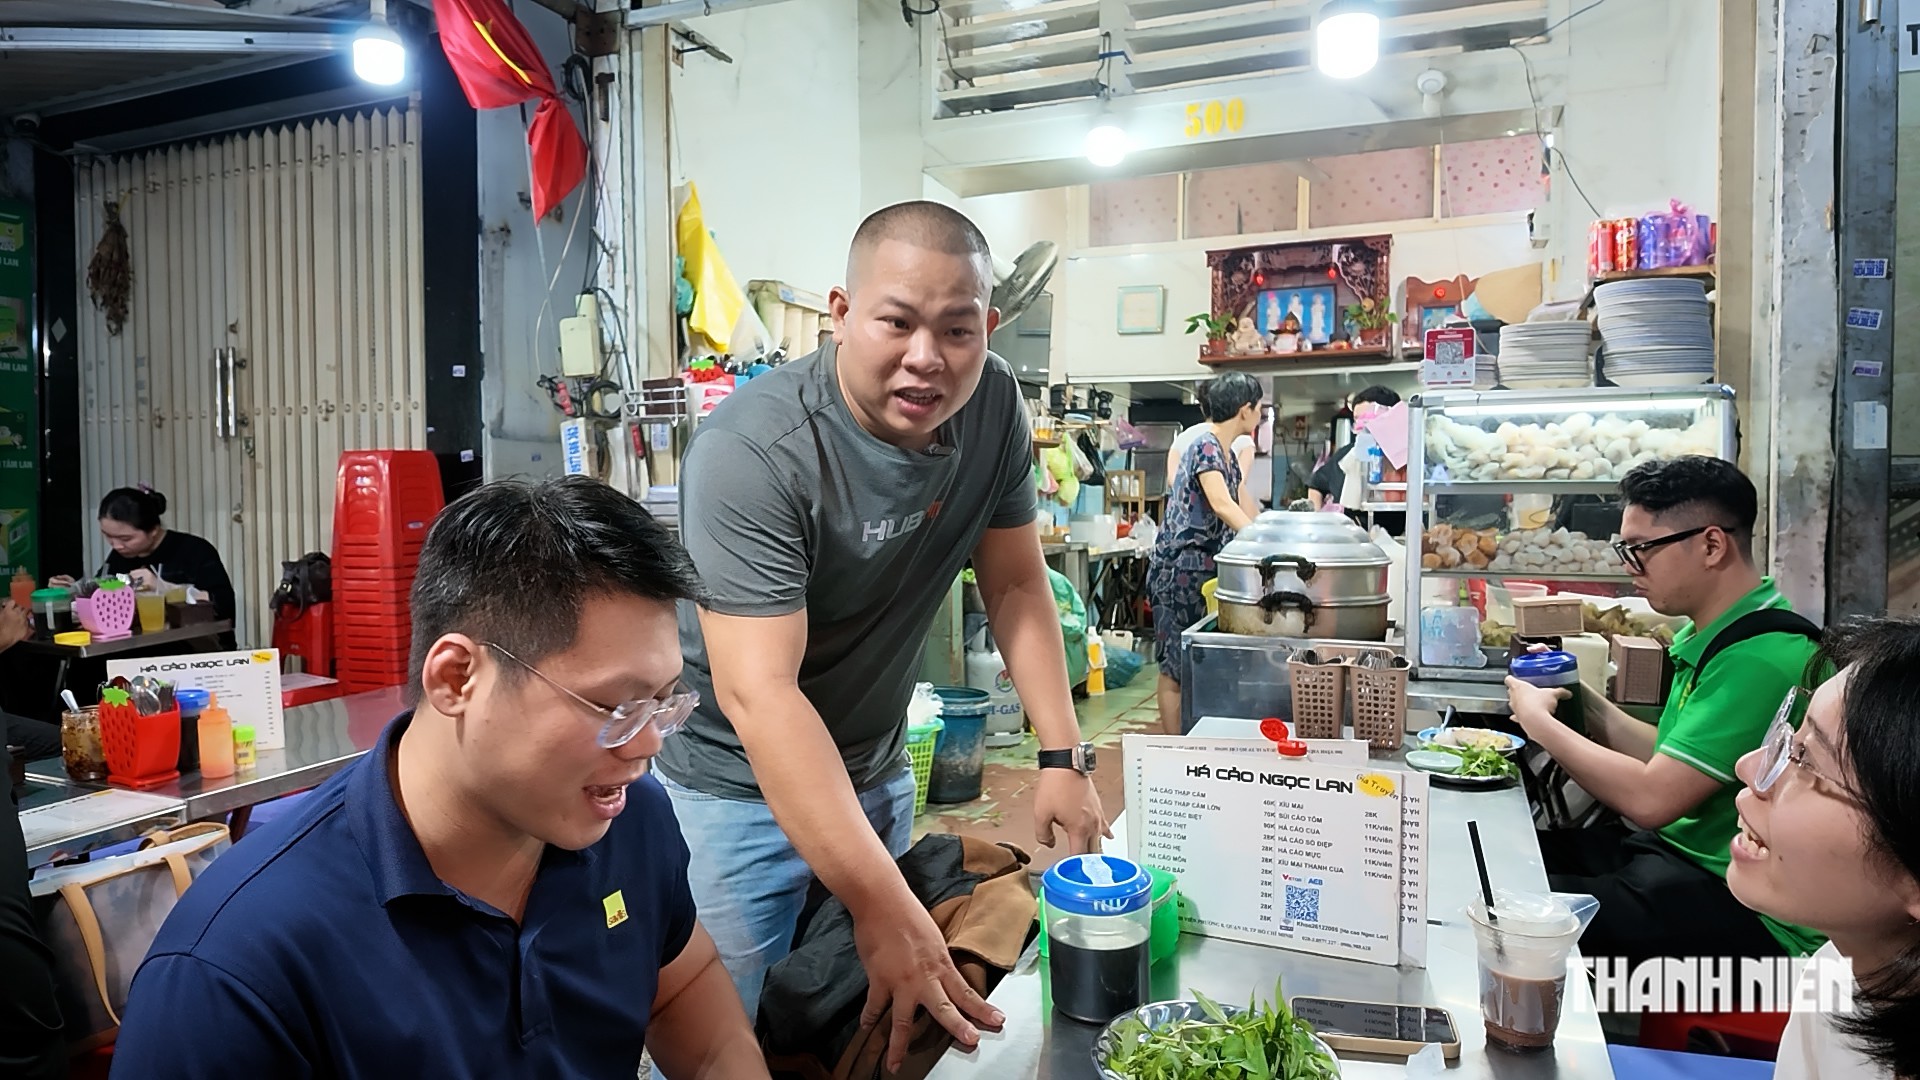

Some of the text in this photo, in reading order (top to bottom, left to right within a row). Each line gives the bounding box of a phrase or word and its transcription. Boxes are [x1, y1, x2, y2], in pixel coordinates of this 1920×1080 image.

[1184, 97, 1245, 137] 500
[862, 511, 925, 542] HUB
[1186, 764, 1210, 779] HÁ
[1259, 772, 1310, 790] NGỌC
[1316, 778, 1353, 794] LAN
